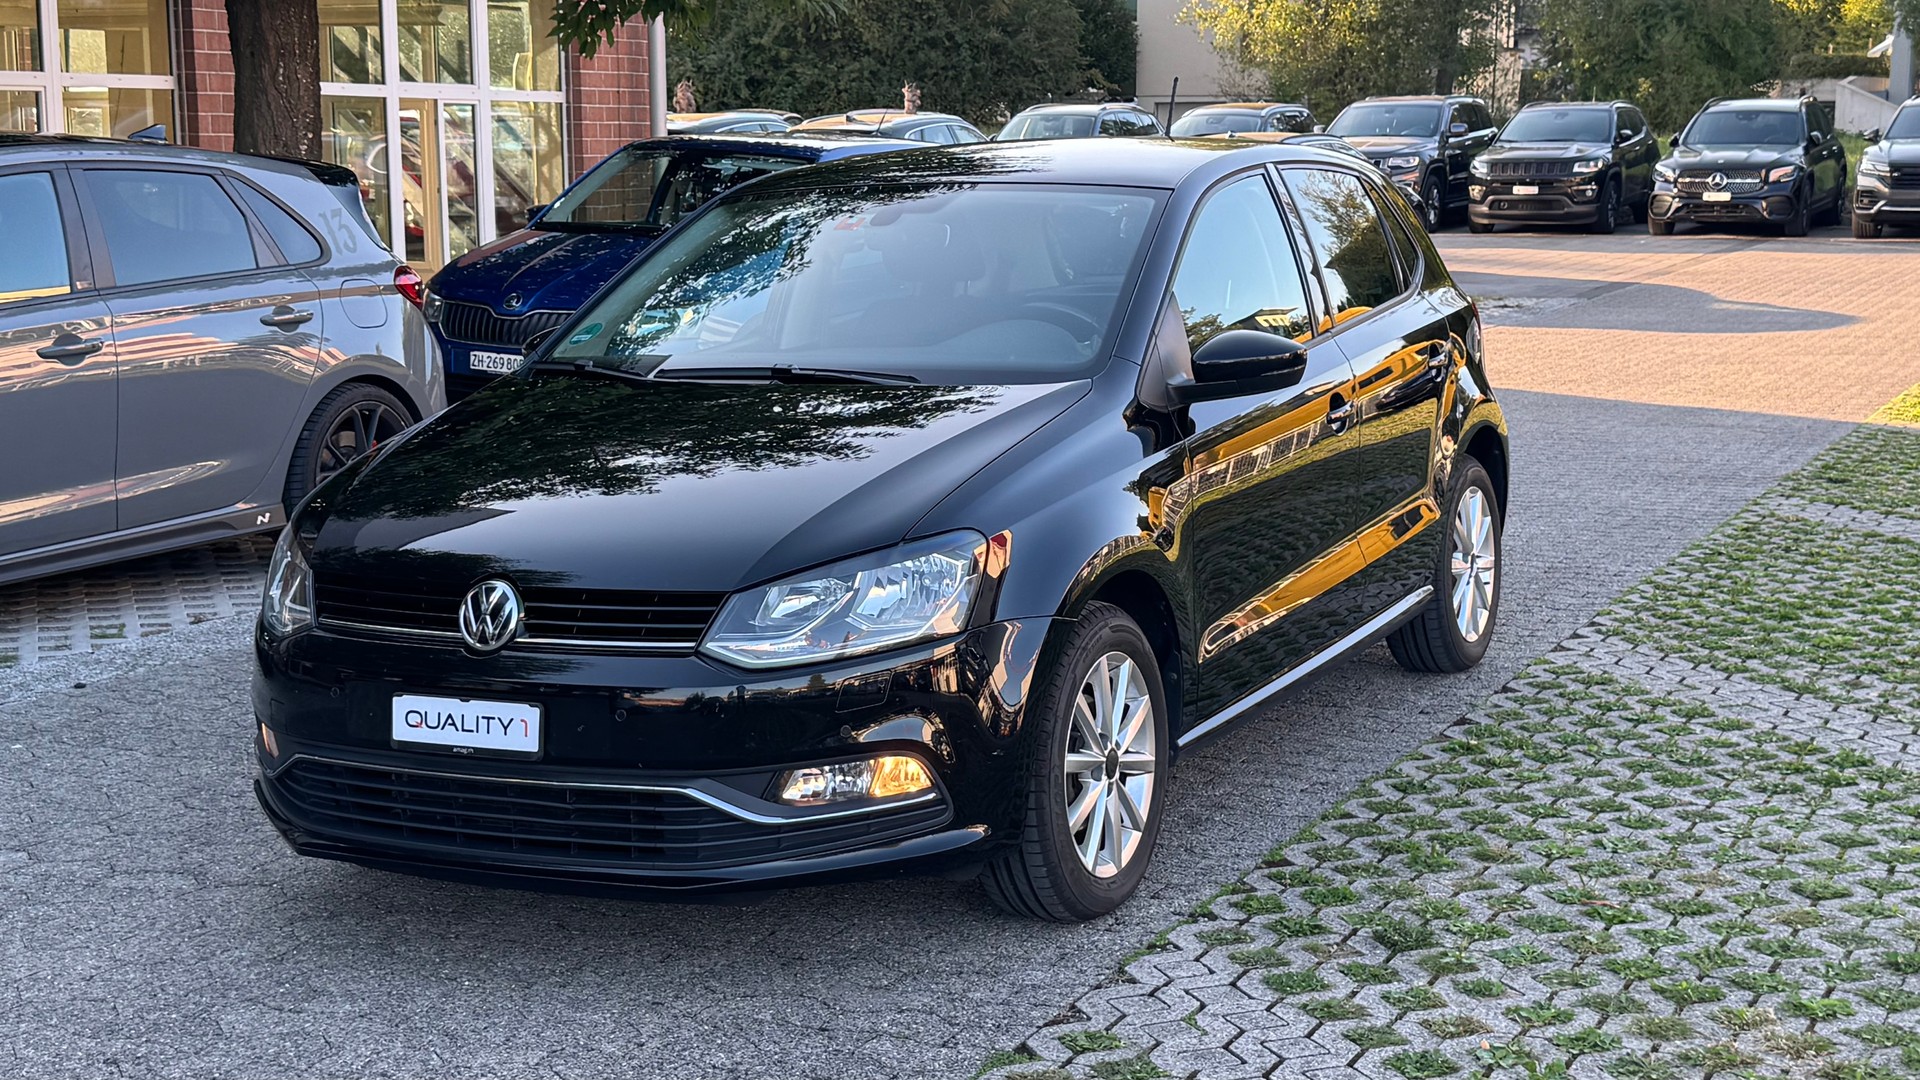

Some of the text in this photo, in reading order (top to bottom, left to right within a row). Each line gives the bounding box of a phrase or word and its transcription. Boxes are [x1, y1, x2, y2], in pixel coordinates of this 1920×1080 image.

[318, 207, 358, 256] 13
[256, 512, 271, 525] N
[460, 581, 518, 650] VW
[404, 709, 528, 738] QUALITY 1
